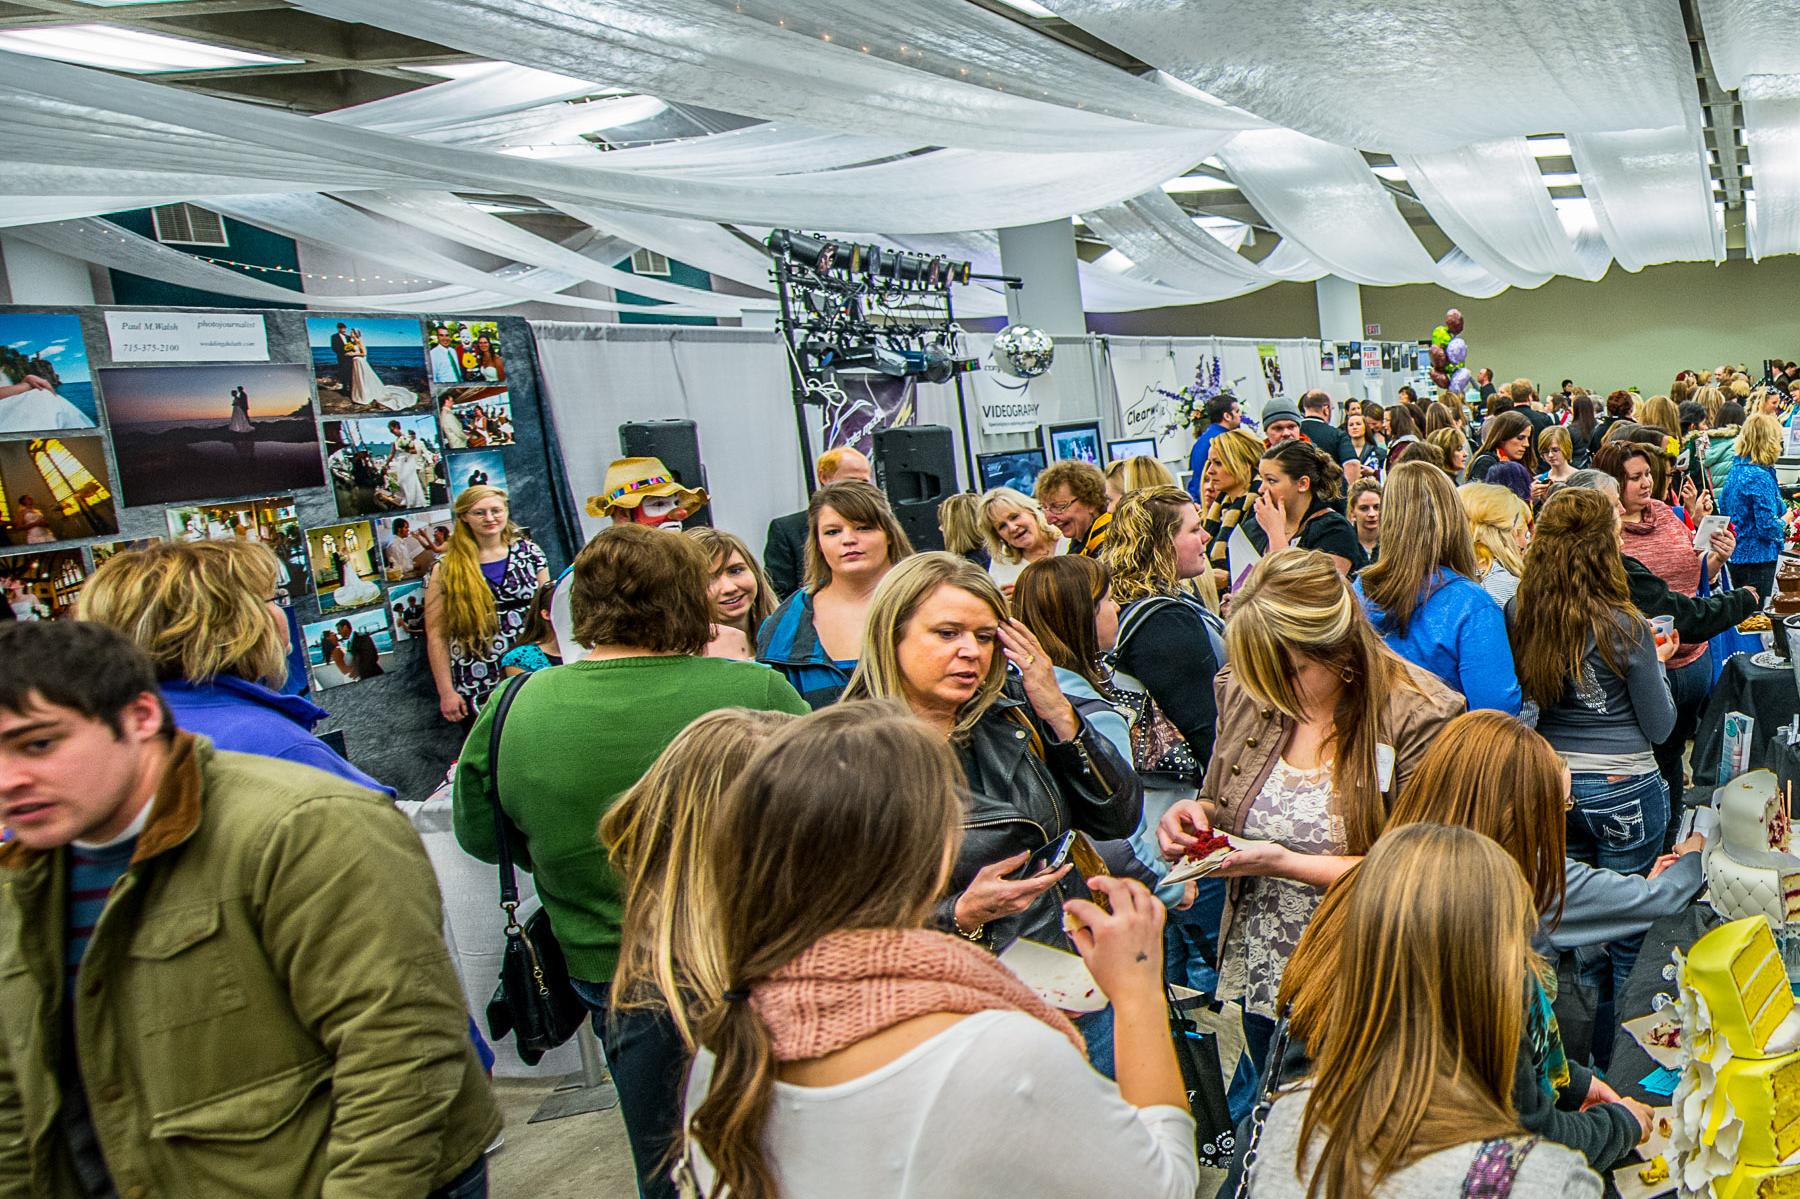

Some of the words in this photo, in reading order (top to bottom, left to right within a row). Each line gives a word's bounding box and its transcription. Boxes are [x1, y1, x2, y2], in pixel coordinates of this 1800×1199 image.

[121, 322, 142, 331] Paul
[197, 320, 256, 330] photojournalist
[122, 343, 180, 353] 715-375-2100
